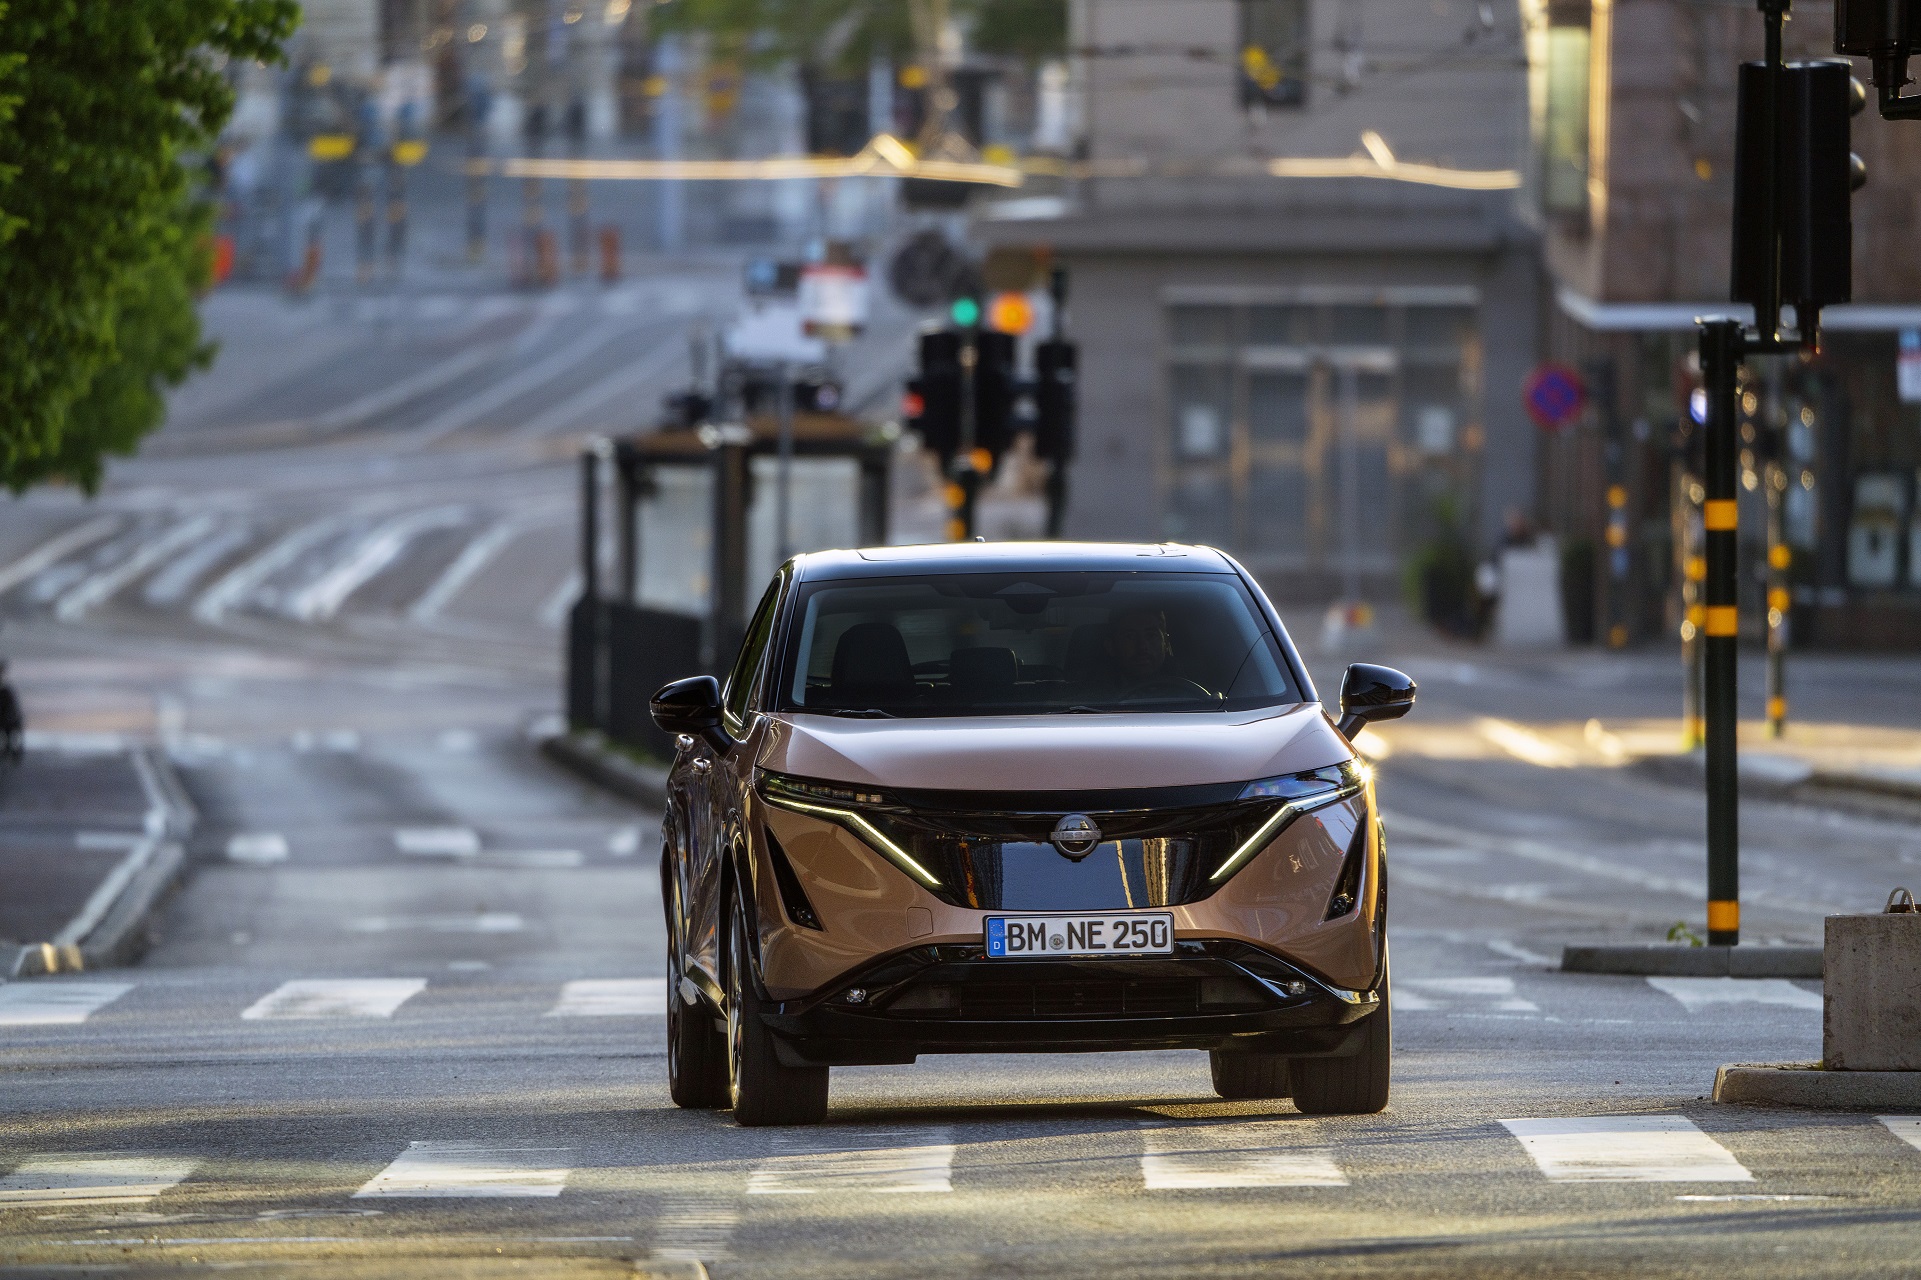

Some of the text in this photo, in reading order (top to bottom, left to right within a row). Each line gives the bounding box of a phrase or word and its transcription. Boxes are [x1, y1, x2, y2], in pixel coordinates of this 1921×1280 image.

[1052, 831, 1100, 840] NISSAN
[1007, 919, 1168, 951] BM NE 250
[993, 941, 1001, 950] D
